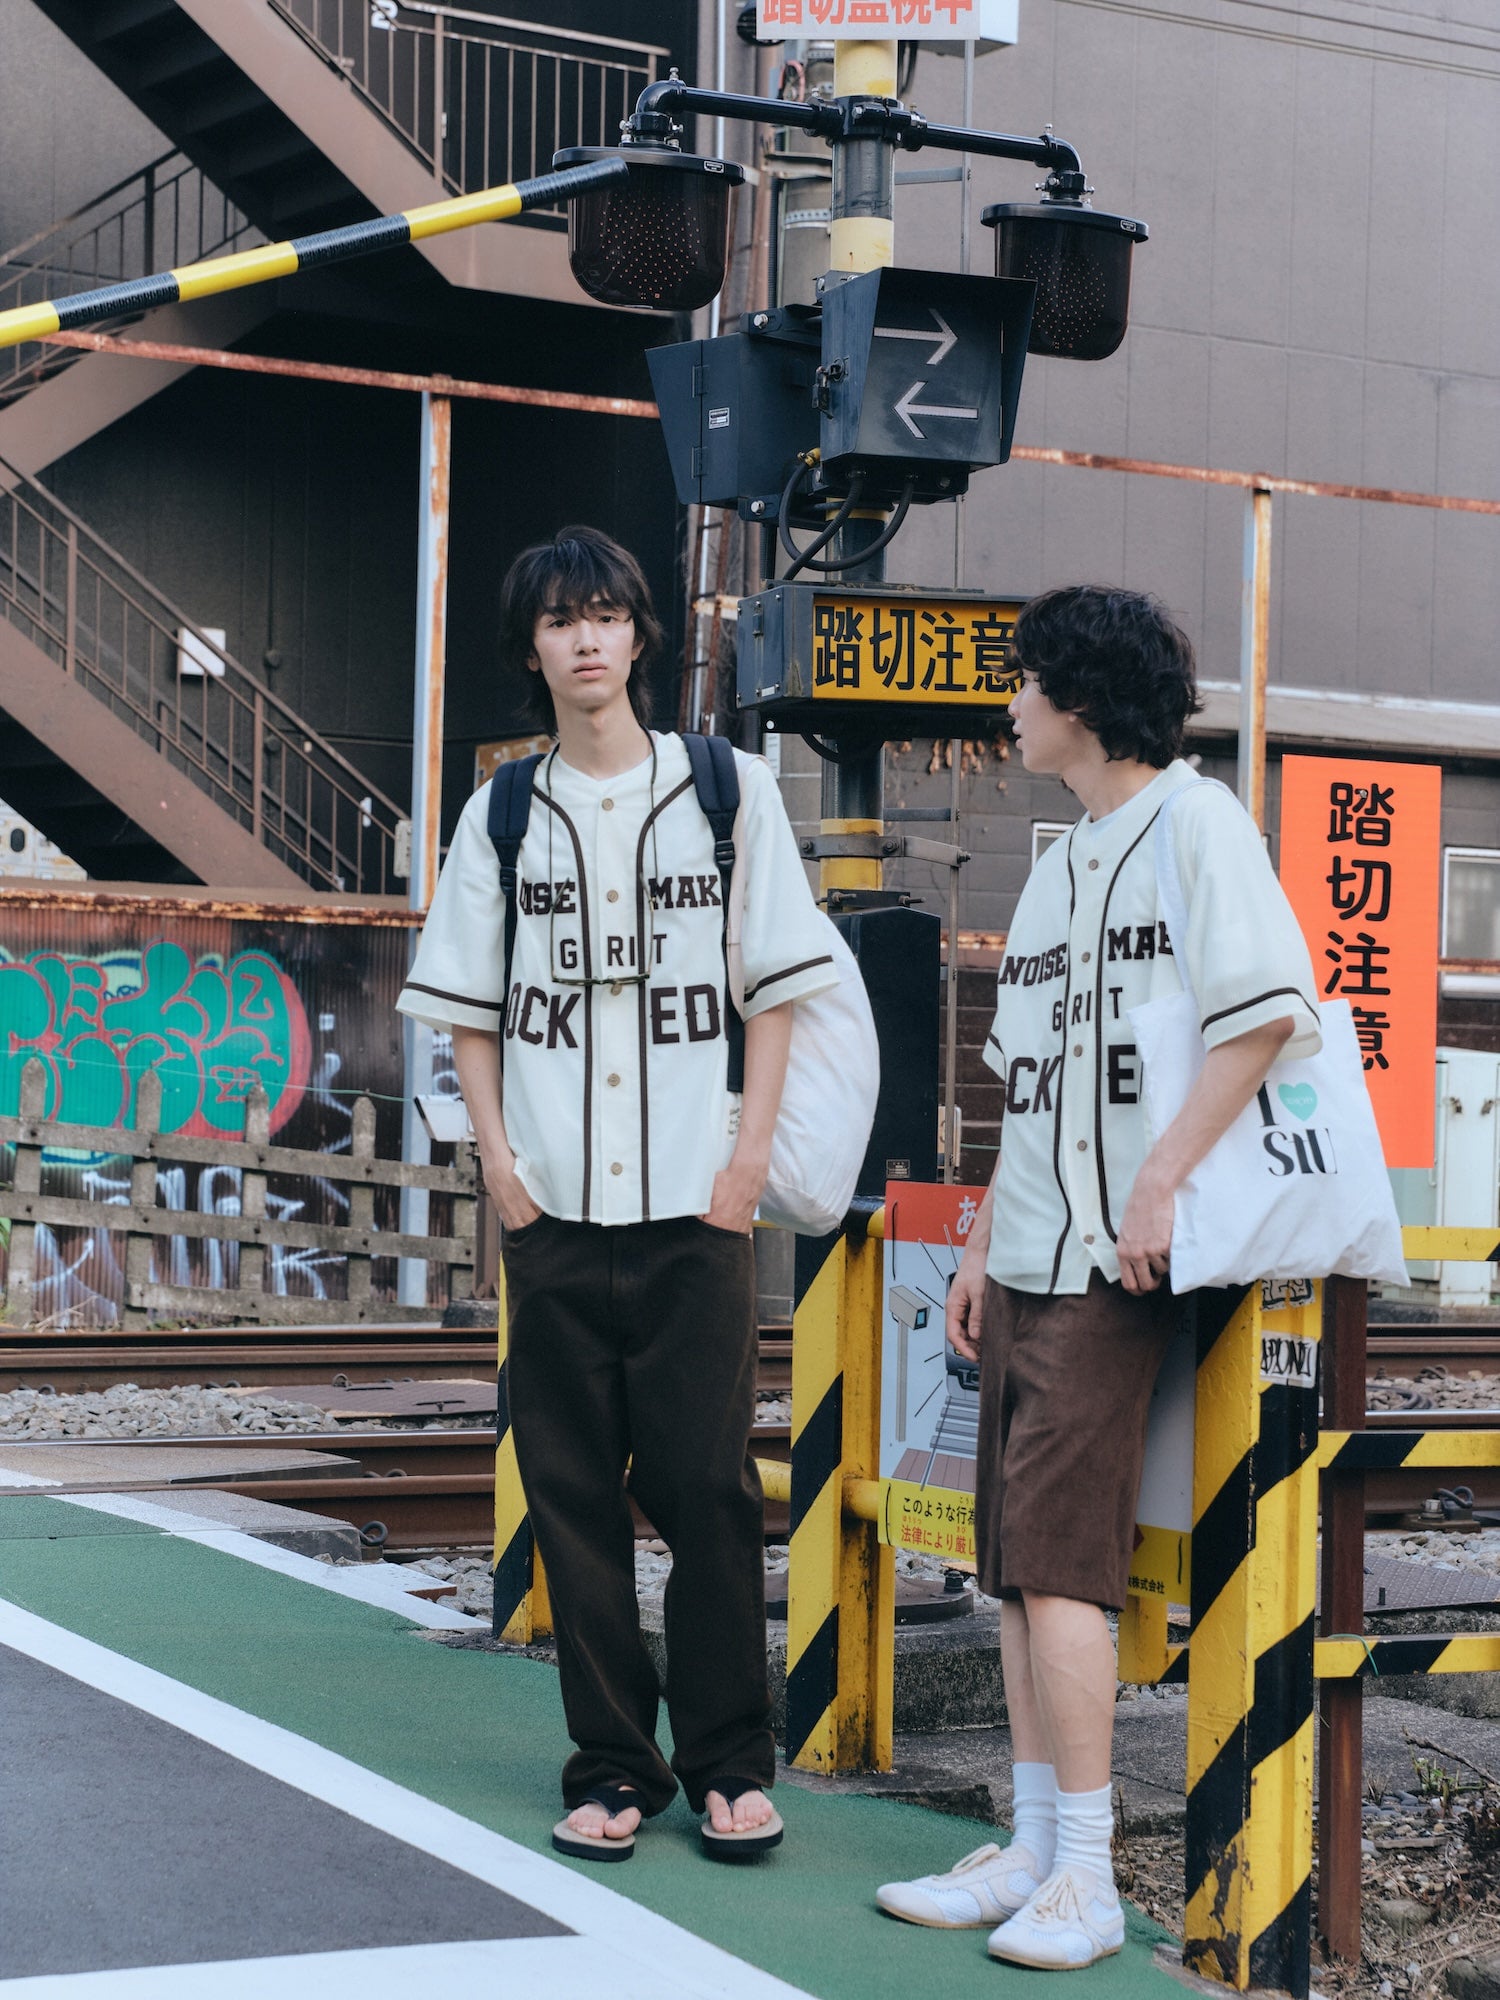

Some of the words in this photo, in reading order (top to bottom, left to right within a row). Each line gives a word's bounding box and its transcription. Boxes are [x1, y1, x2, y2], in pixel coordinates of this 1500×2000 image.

[815, 605, 1018, 694] 踏切注意
[998, 942, 1067, 987] NOISE
